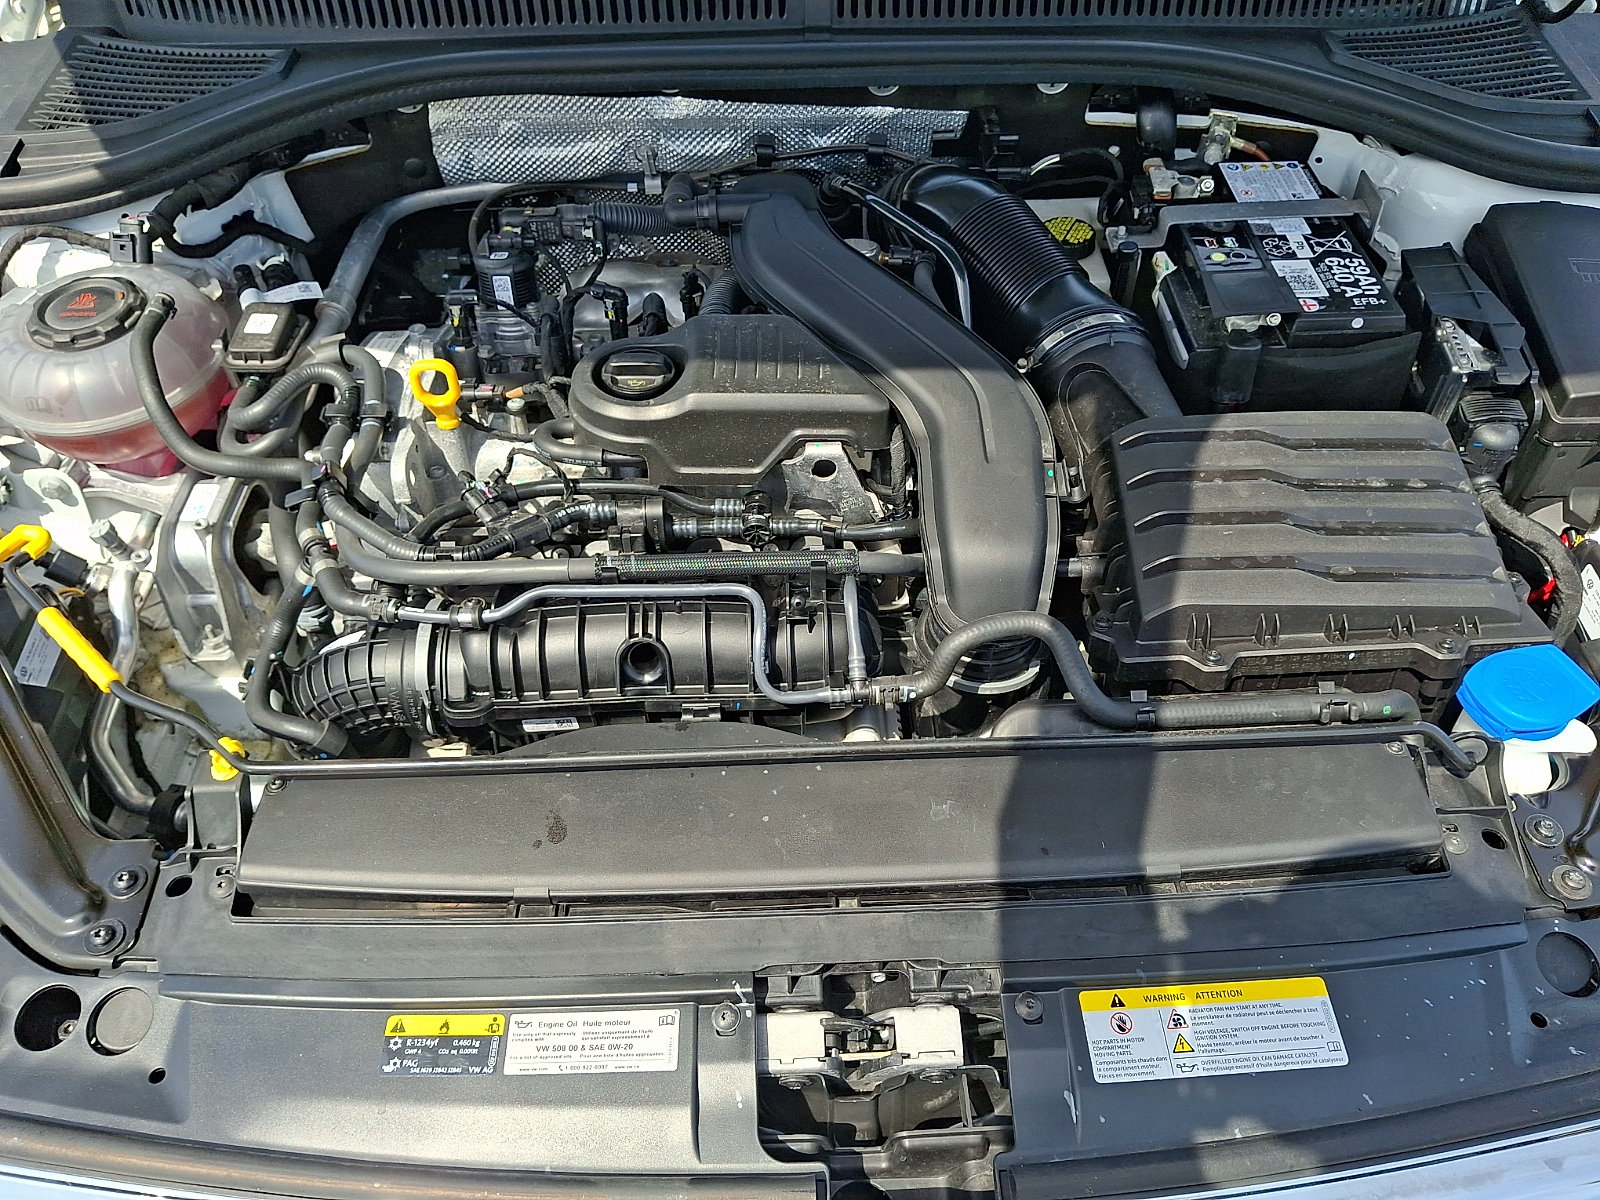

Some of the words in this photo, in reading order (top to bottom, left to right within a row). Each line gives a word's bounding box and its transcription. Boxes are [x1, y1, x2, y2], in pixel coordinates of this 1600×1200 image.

[1325, 257, 1355, 282] 640
[1340, 286, 1363, 297] A
[1344, 258, 1381, 295] 59Ah
[1352, 297, 1387, 306] EFB+
[1143, 993, 1185, 1002] WARNING
[1196, 989, 1242, 1000] ATTENTION
[406, 1038, 439, 1048] R-1234yf
[472, 1039, 480, 1047] kg
